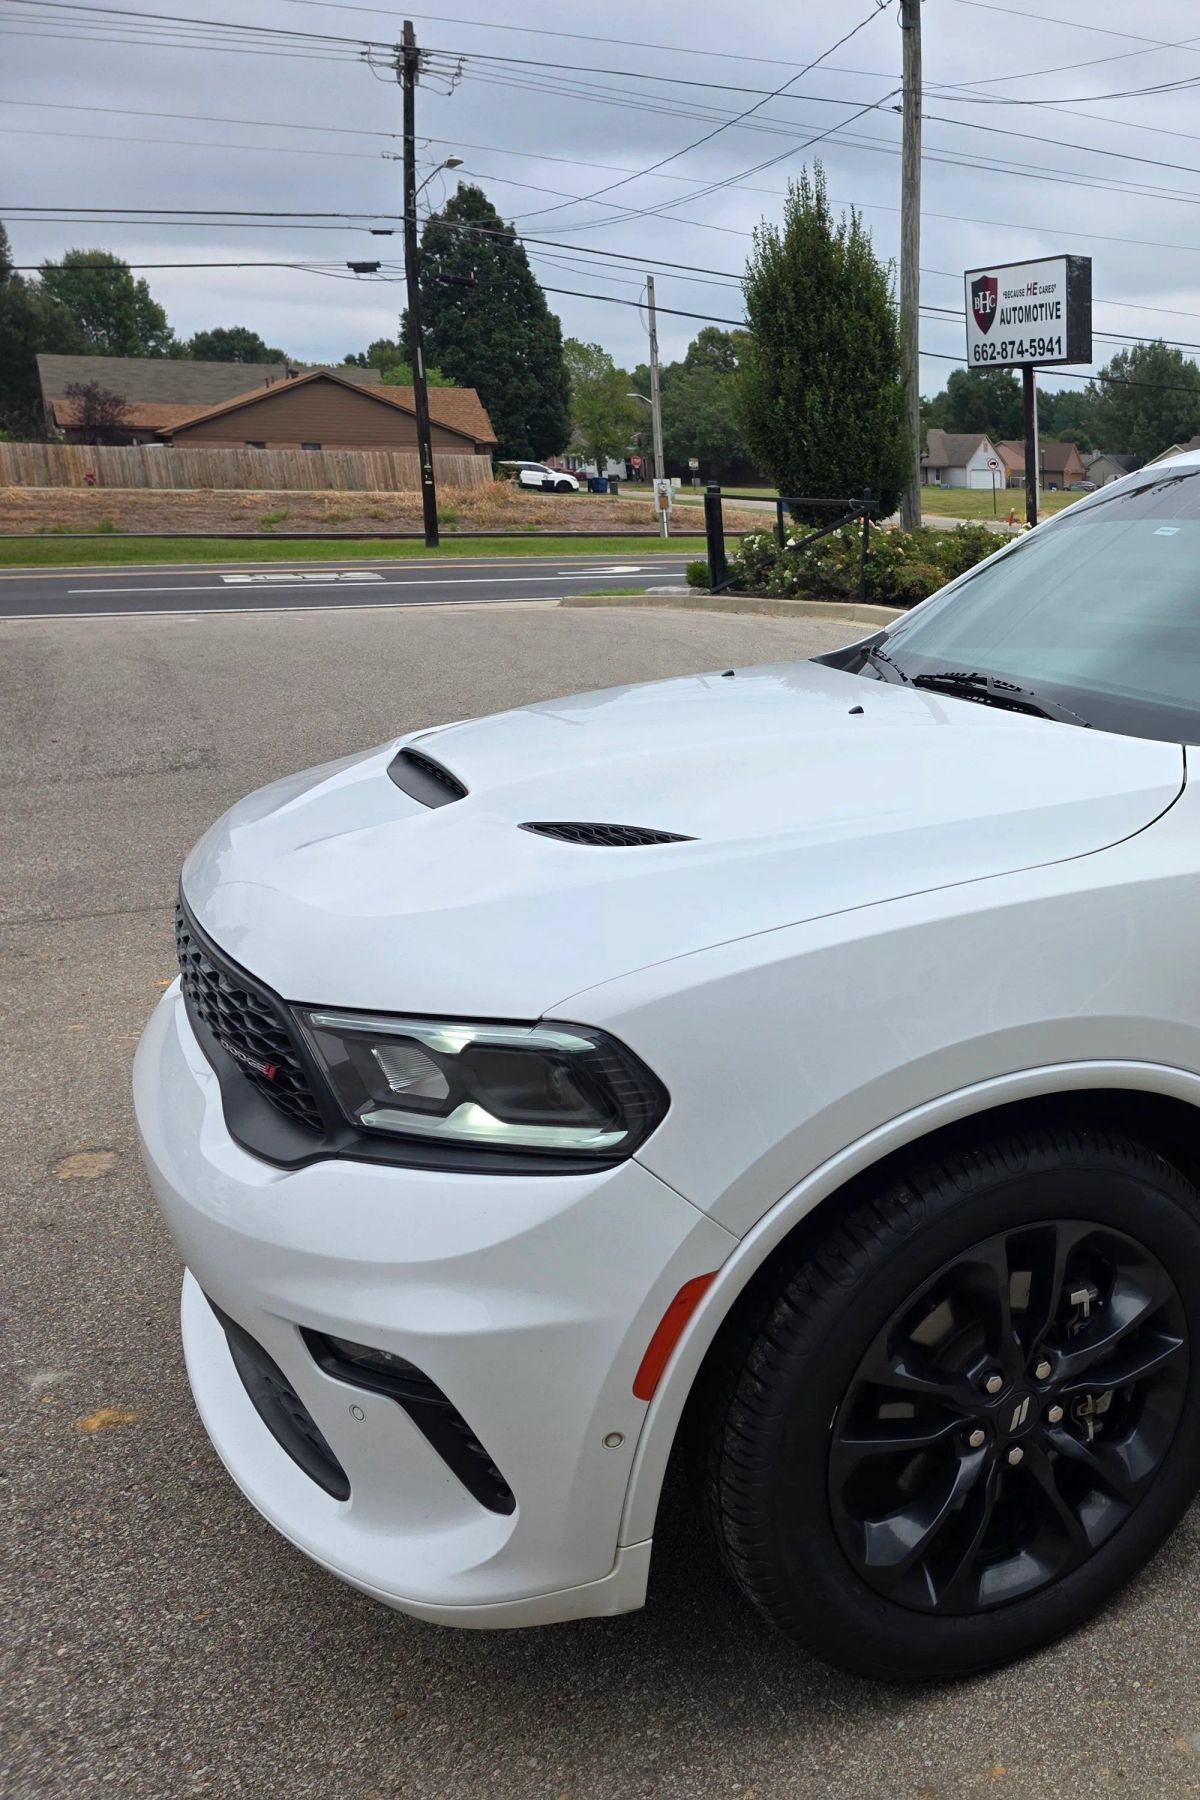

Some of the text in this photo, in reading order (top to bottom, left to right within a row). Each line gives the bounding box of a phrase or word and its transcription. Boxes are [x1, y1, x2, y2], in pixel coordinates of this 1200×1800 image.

[1026, 282, 1038, 296] HE
[999, 301, 1061, 326] AUTOMOTIVE
[973, 336, 1062, 362] 662-874-5941
[220, 1039, 267, 1075] DODGE
